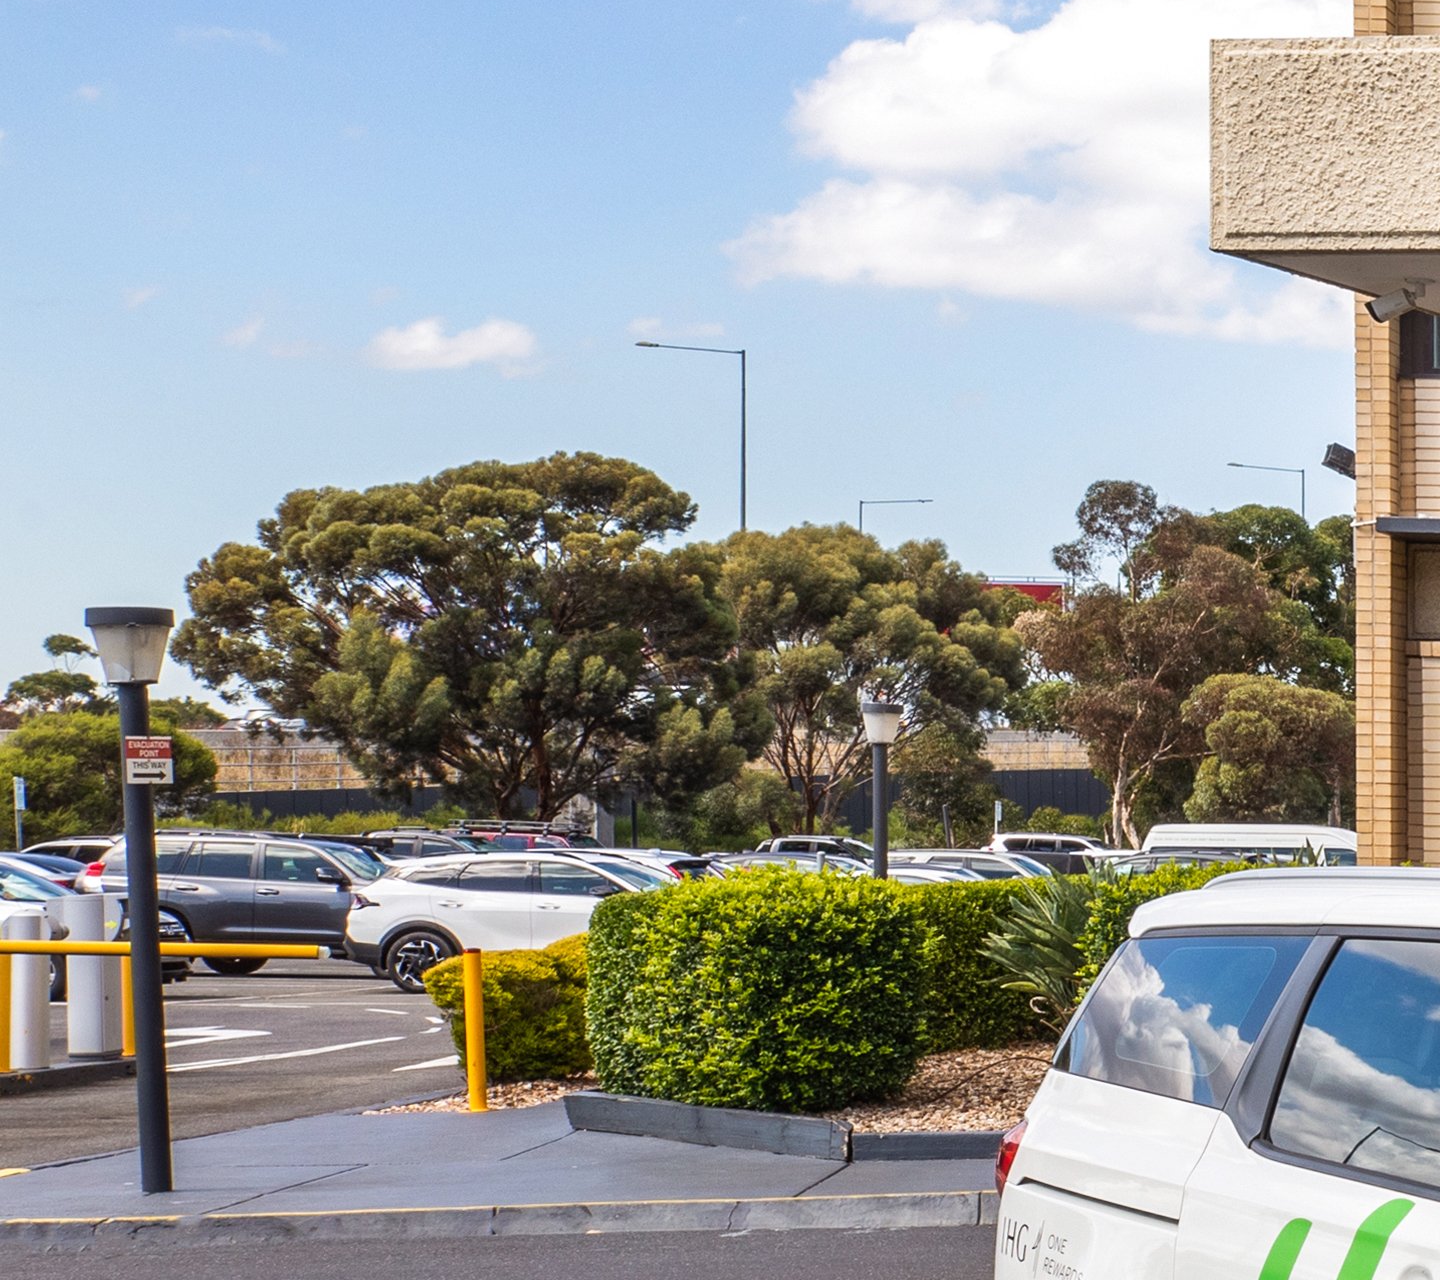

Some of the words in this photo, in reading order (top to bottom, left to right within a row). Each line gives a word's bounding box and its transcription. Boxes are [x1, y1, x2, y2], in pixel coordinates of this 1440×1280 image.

[132, 761, 150, 769] THIS
[151, 761, 167, 769] WAY
[1001, 1217, 1029, 1262] IHG
[1047, 1234, 1068, 1255] ONE
